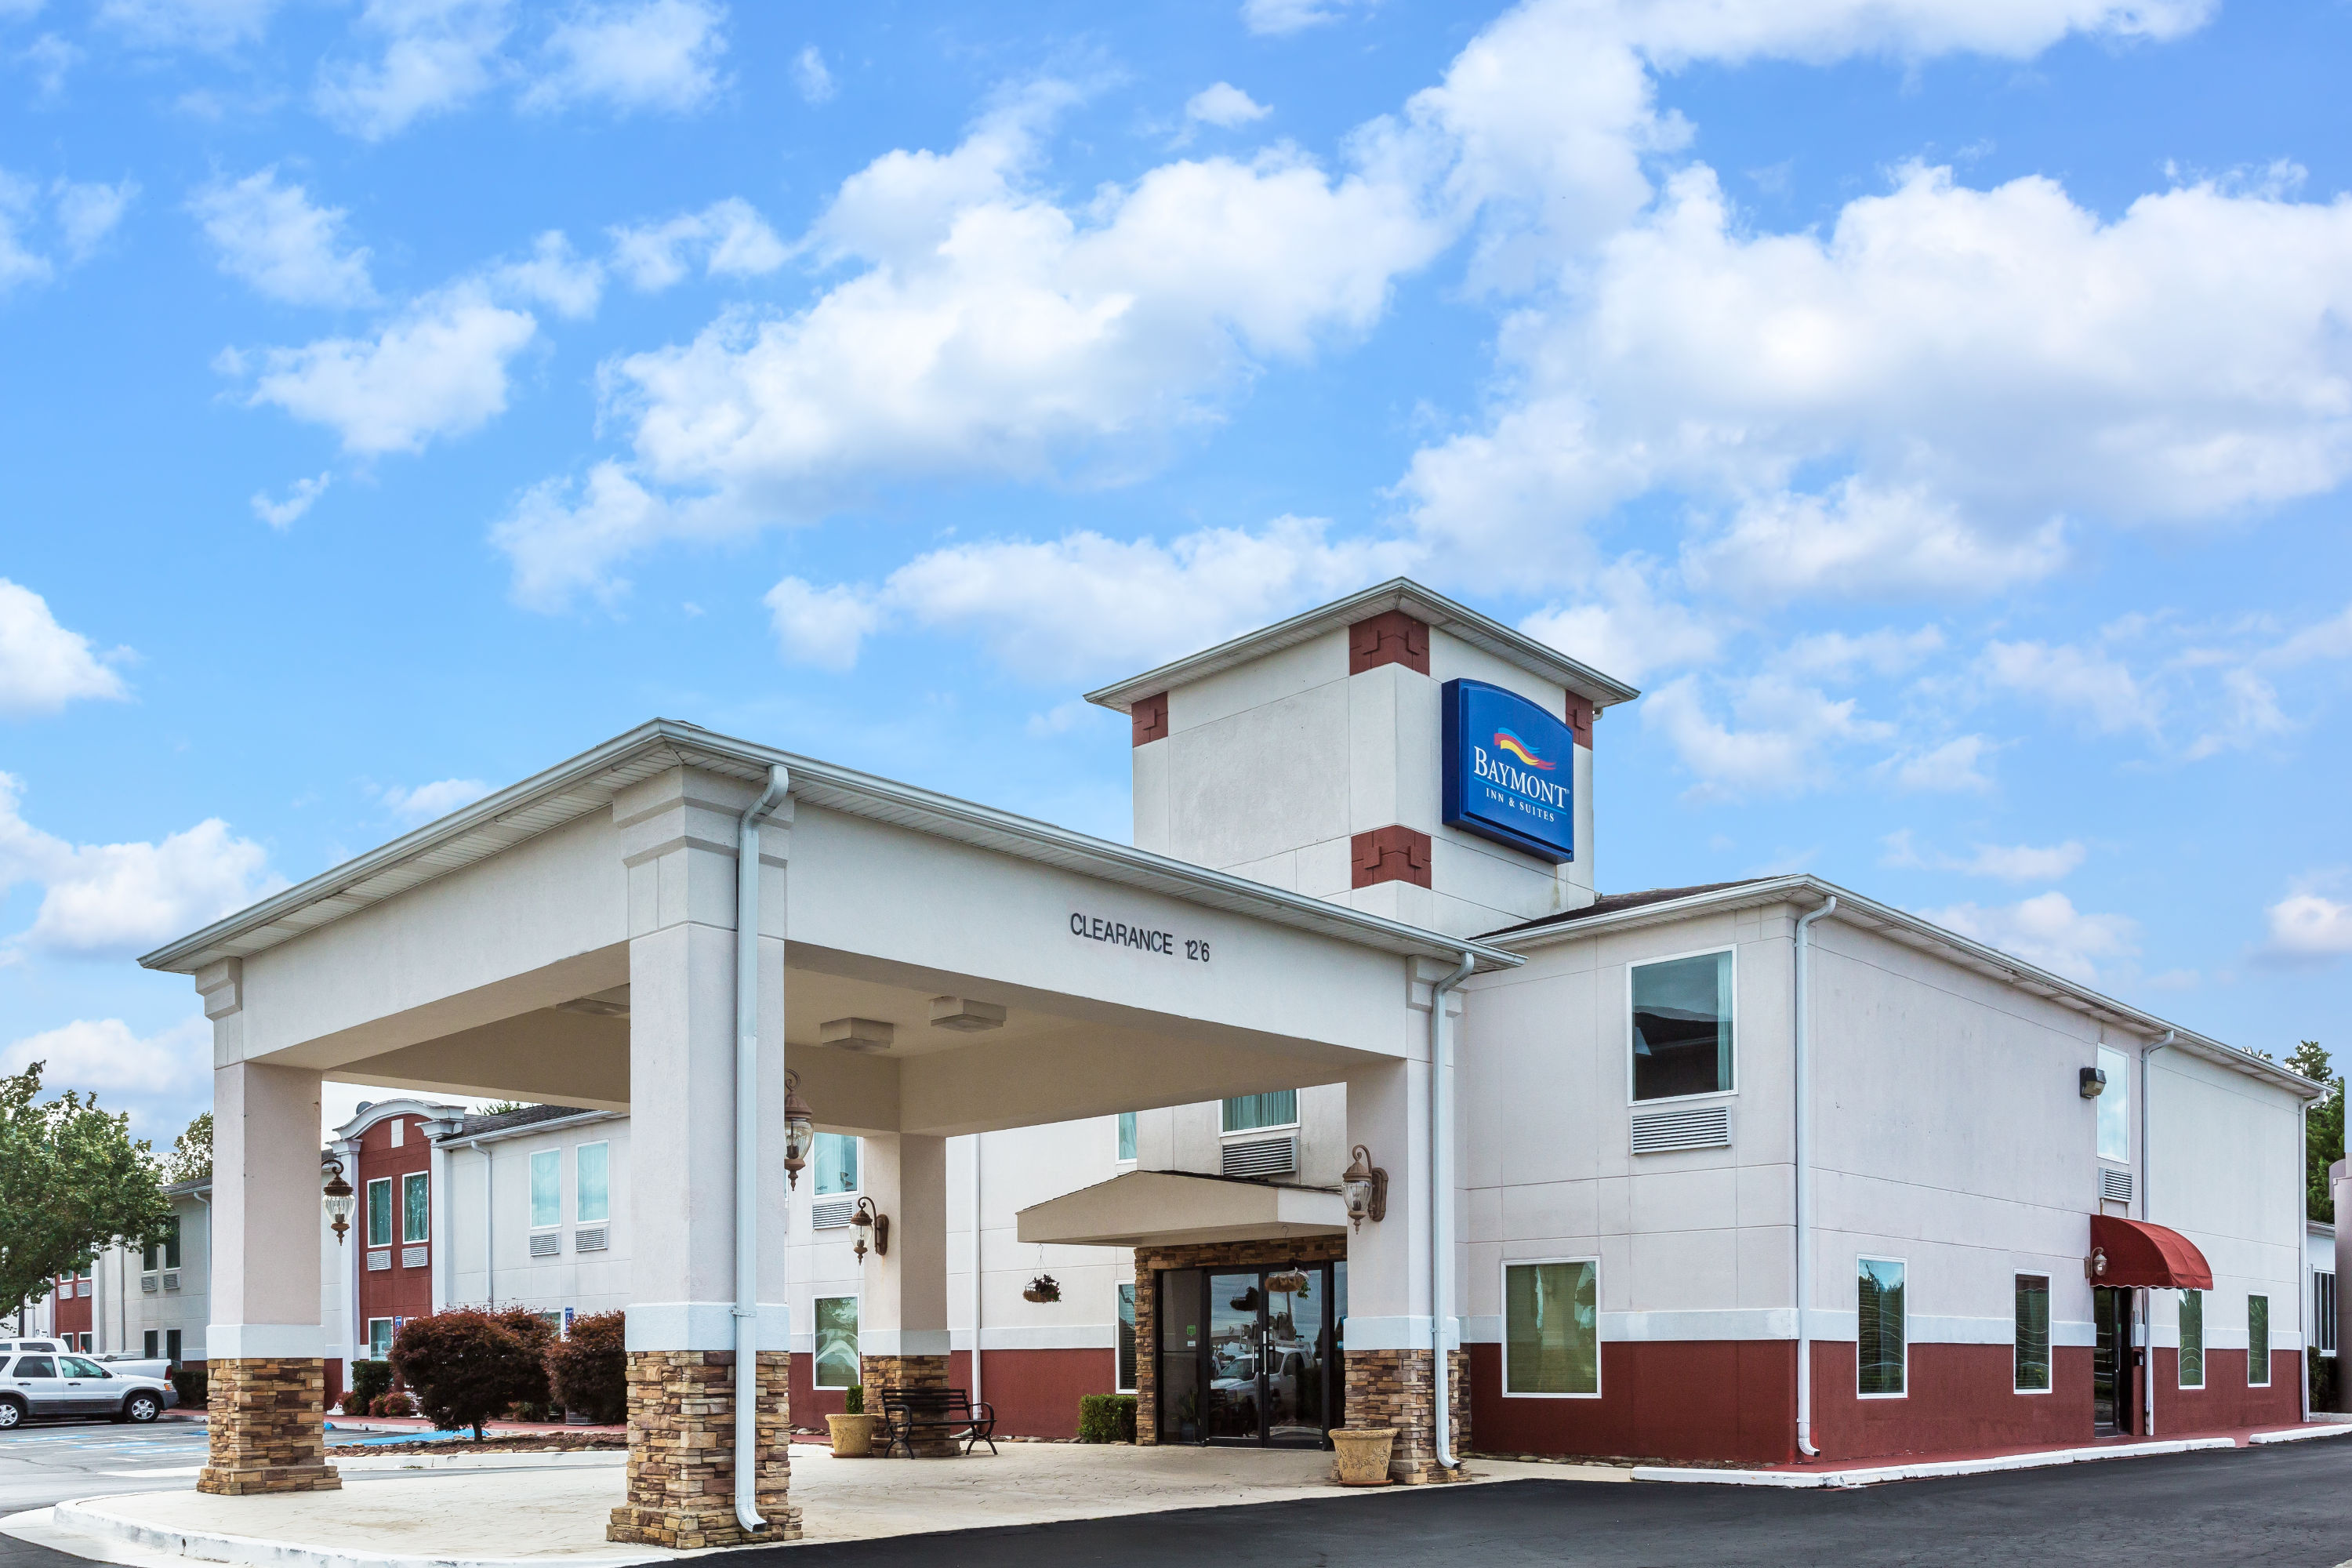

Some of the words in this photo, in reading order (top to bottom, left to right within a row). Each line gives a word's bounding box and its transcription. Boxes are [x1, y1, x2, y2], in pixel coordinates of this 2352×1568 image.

[1474, 746, 1567, 808] BAYMONT
[1486, 788, 1504, 803] INN
[1508, 797, 1515, 808] &
[1519, 801, 1555, 822] SUITES
[1070, 913, 1173, 955] CLEARANCE
[1185, 939, 1210, 962] 12'6
